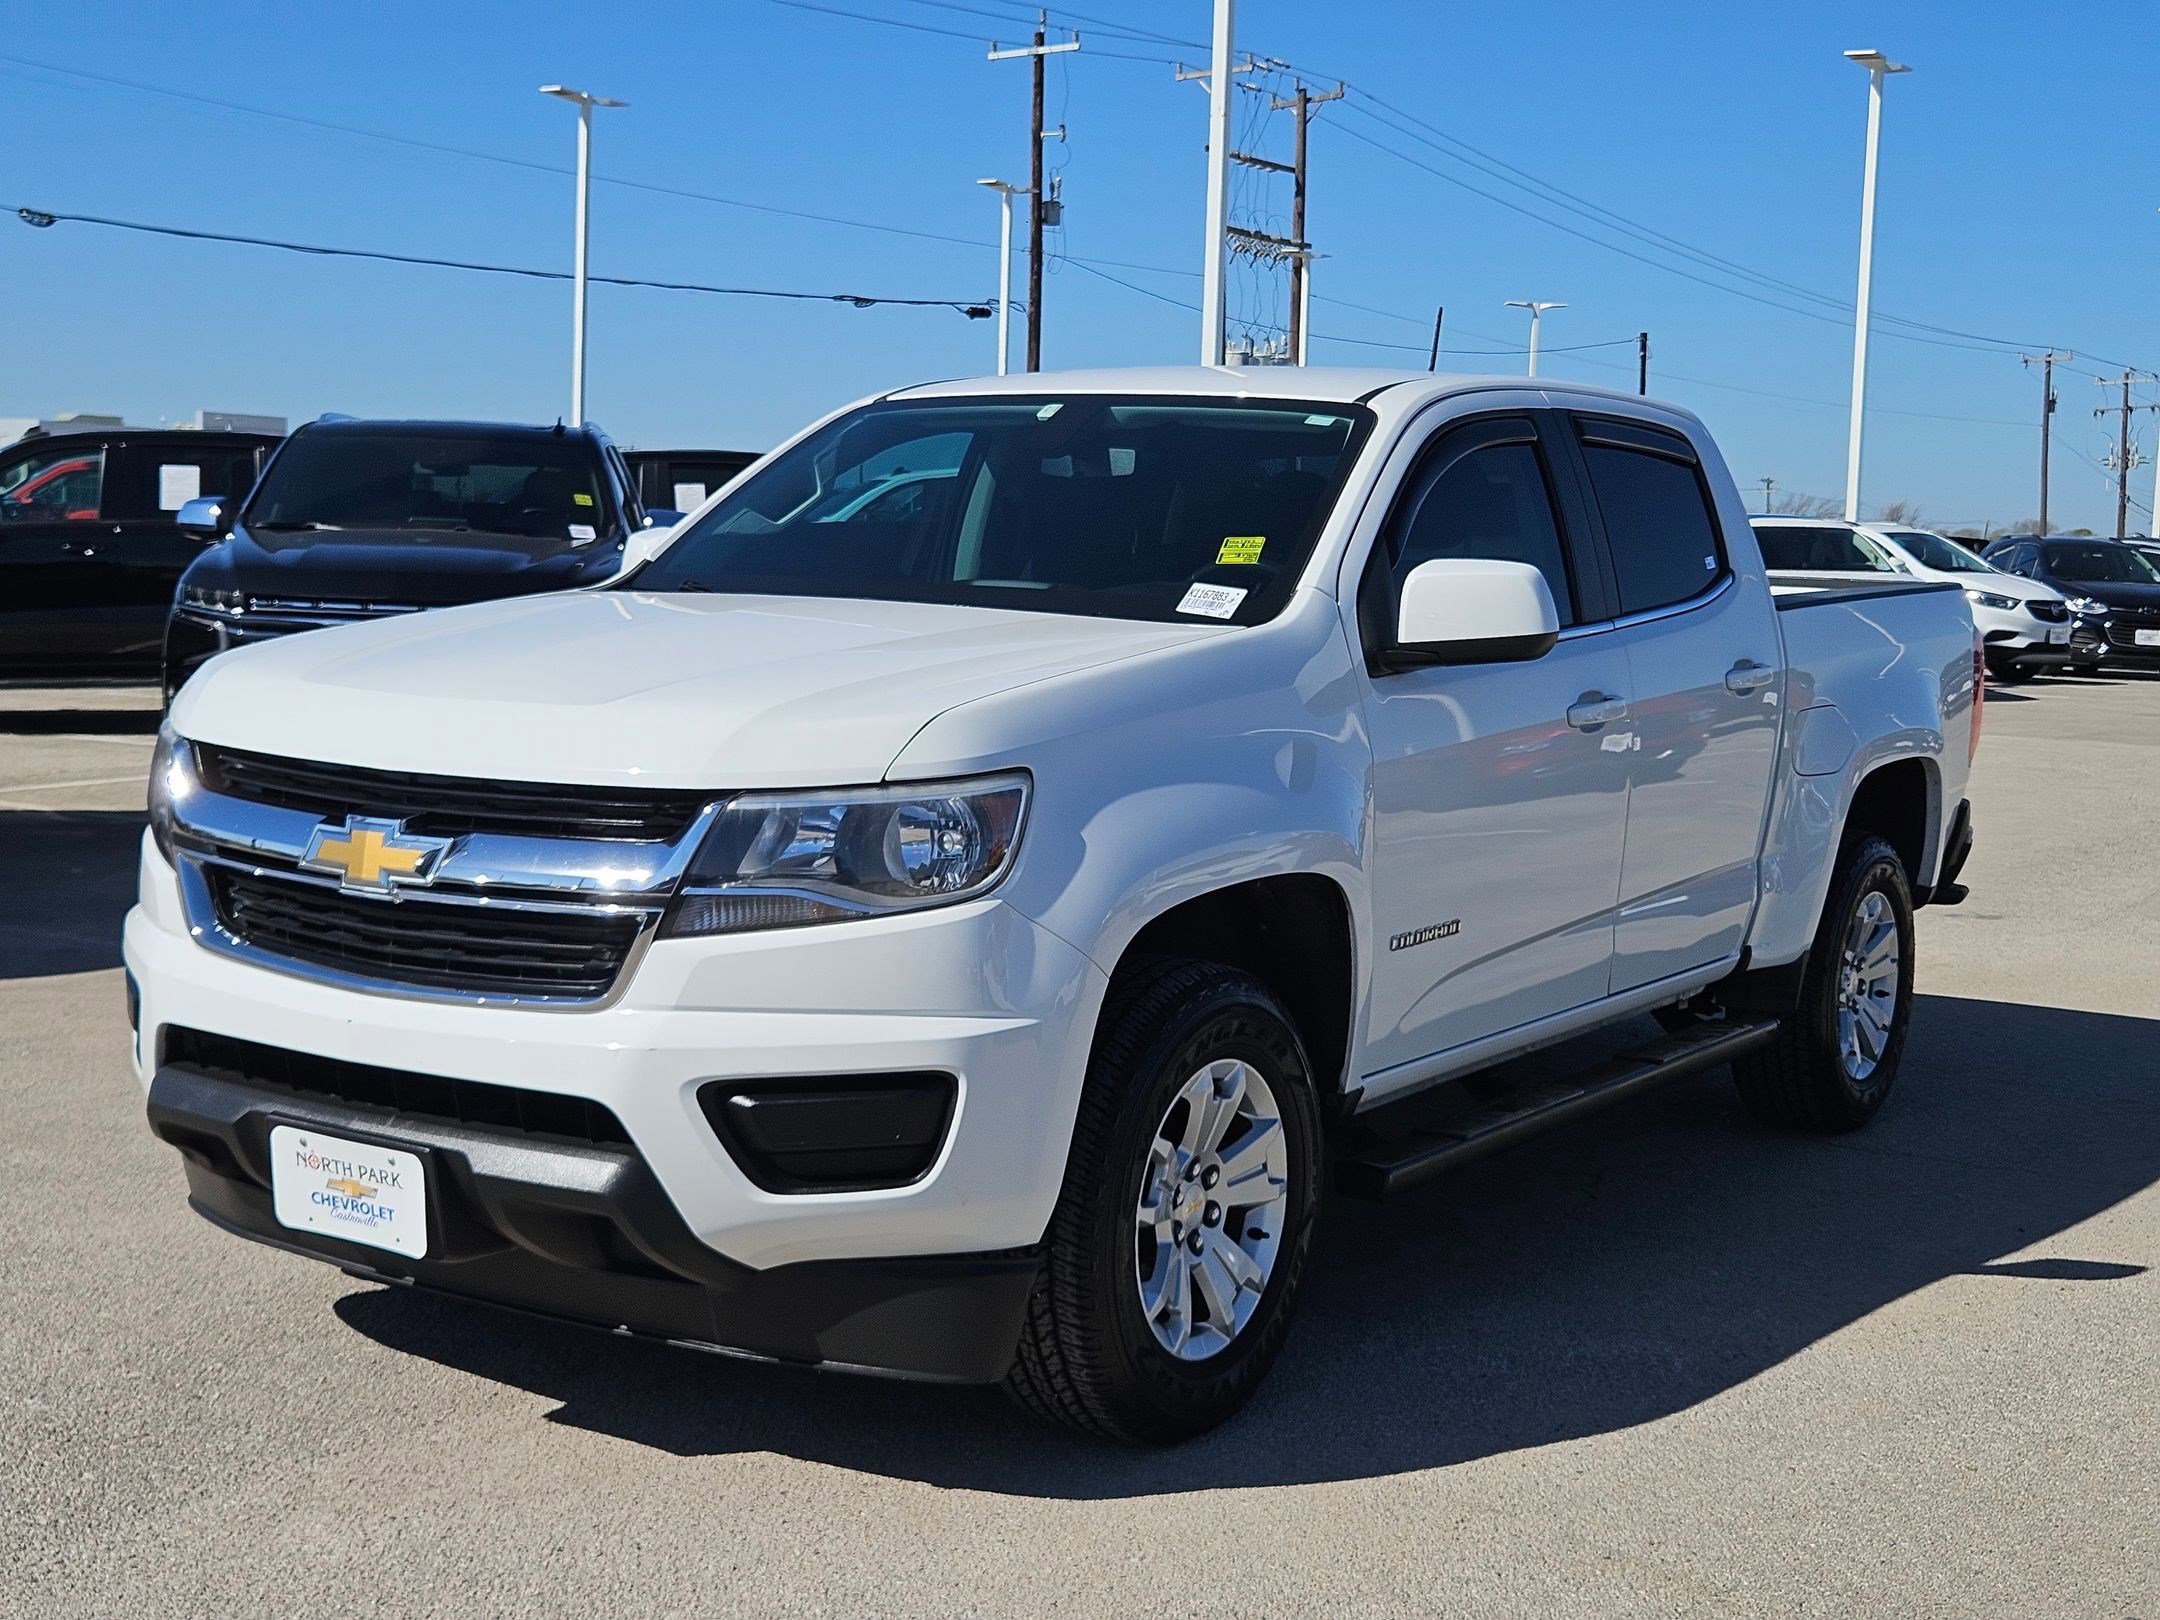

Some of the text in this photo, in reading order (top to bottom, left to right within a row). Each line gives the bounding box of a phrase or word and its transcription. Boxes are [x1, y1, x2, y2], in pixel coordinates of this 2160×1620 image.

[1187, 588, 1230, 602] K1167883
[296, 1150, 404, 1189] NORTH PARK
[311, 1191, 395, 1221] CHEVROLET
